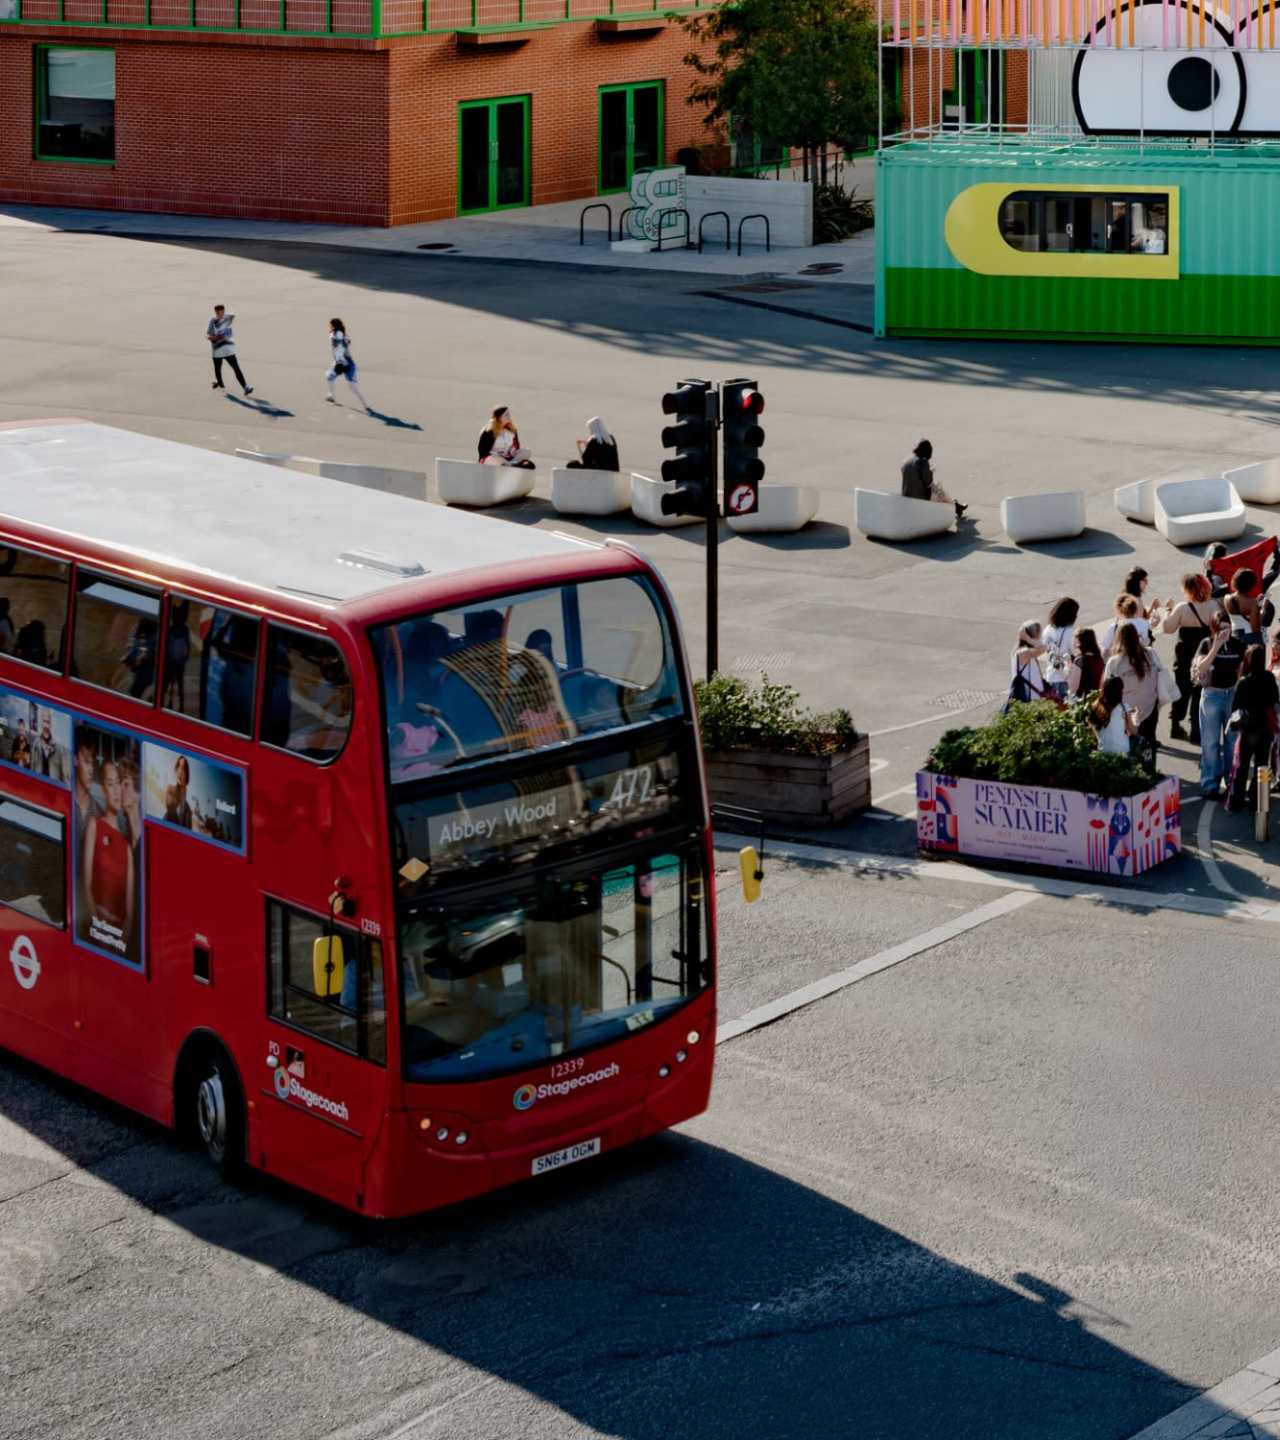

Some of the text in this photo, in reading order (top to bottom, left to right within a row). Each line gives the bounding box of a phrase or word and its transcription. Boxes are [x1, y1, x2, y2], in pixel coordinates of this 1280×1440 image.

[607, 766, 652, 810] 472
[975, 783, 1069, 812] PENINSULA
[439, 795, 558, 846] Abbey Wood
[975, 804, 1069, 836] SUMMER
[537, 1061, 620, 1096] Stagecoach
[551, 1057, 585, 1079] 12339
[289, 1077, 349, 1121] Stagecoach
[537, 1150, 568, 1171] SN64
